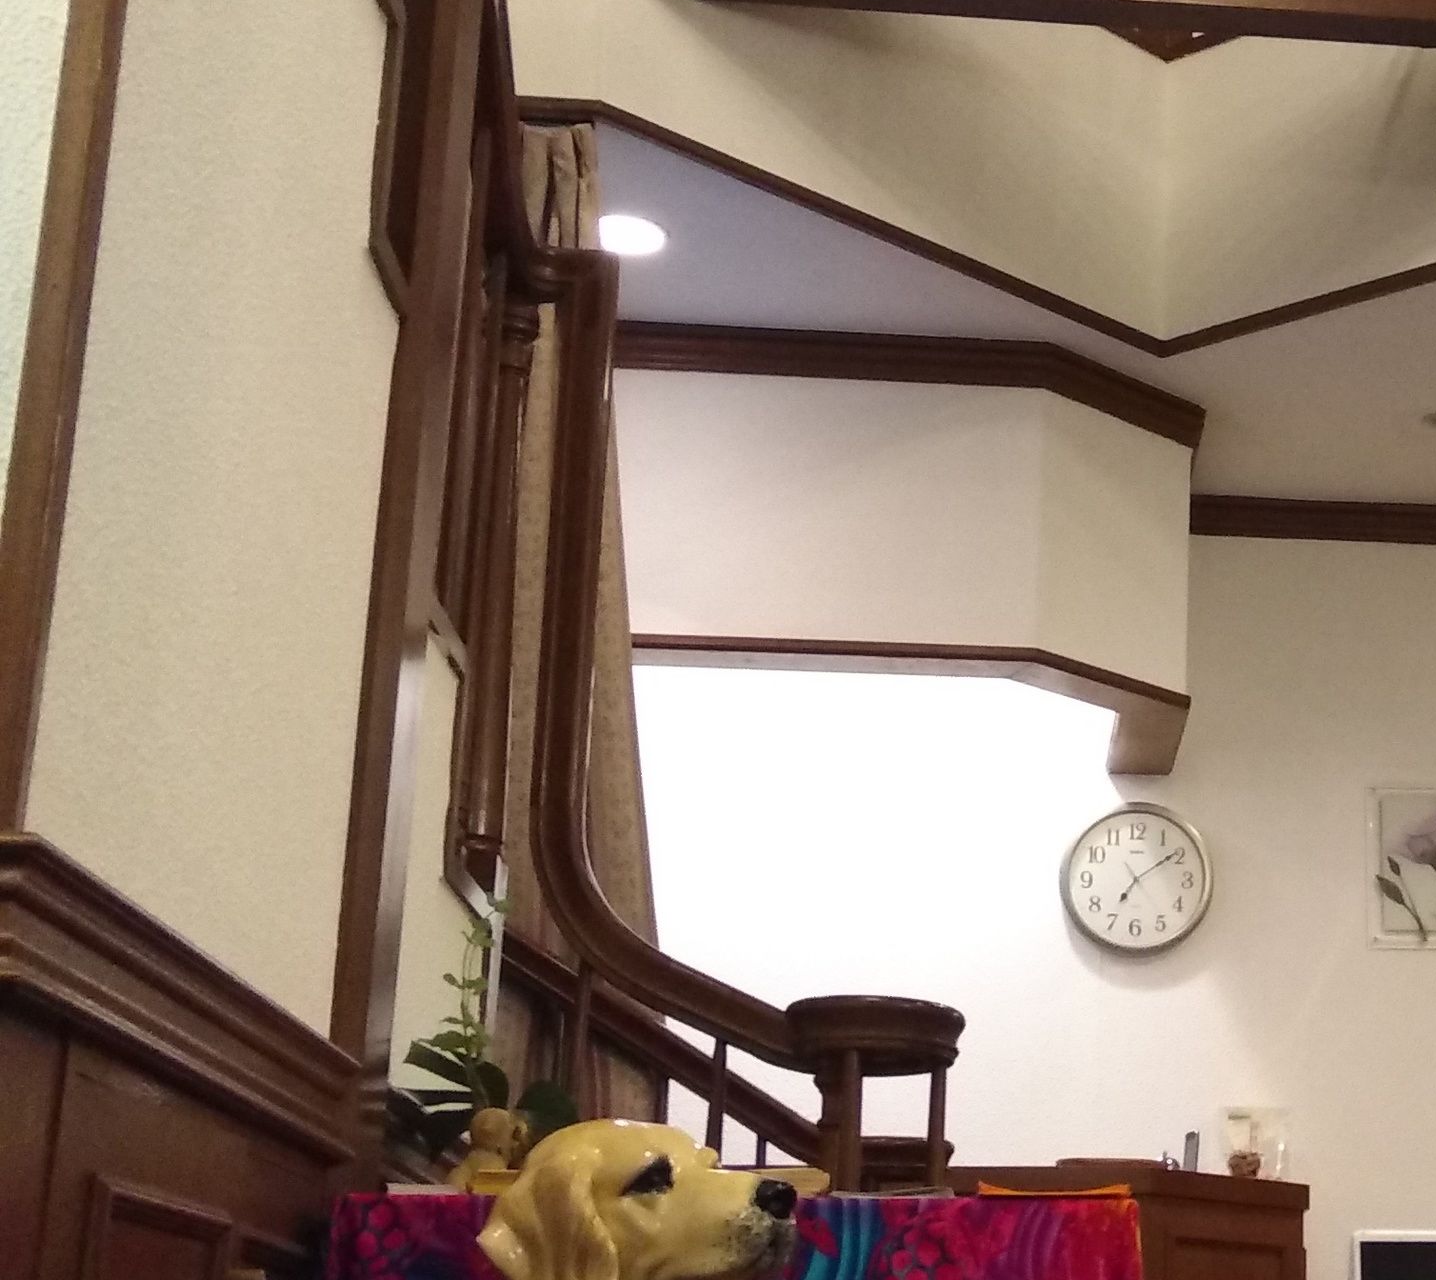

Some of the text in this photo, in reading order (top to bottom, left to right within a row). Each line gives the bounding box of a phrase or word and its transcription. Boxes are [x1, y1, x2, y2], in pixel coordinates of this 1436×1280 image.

[1106, 828, 1120, 846] 11
[1129, 822, 1146, 841] 12
[1160, 828, 1167, 847] 1
[1088, 846, 1106, 864] 10
[1173, 847, 1186, 865] 2
[1080, 870, 1093, 889] 9
[1181, 870, 1194, 889] 3
[1088, 895, 1102, 913] 8
[1173, 895, 1184, 913] 4
[1106, 913, 1119, 931] 7
[1128, 918, 1142, 937] 6
[1155, 914, 1167, 932] 5
